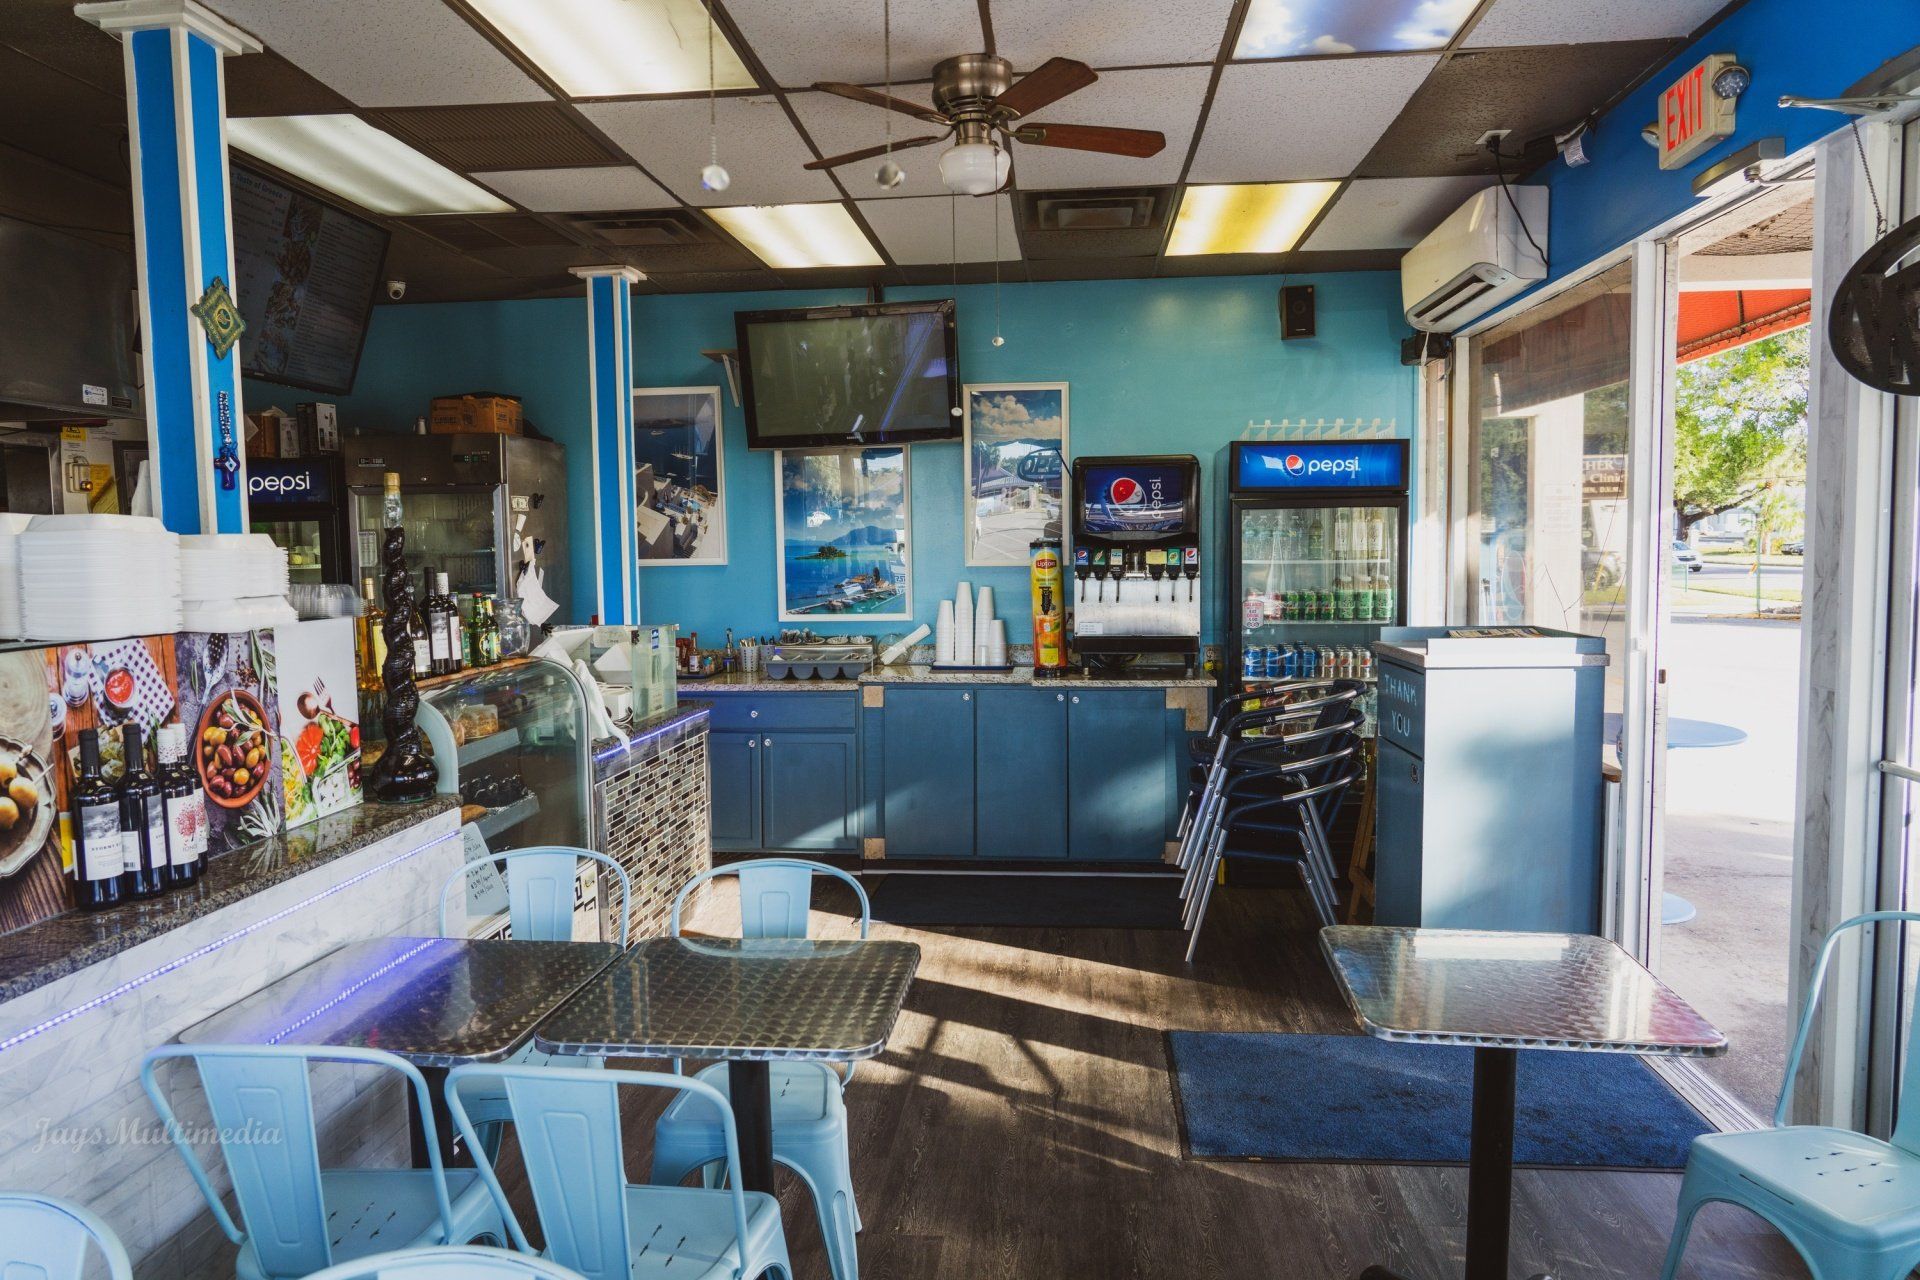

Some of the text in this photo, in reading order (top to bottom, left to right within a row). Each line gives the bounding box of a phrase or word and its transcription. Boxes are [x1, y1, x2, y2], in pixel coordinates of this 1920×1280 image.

[1665, 65, 1705, 152] EXIT
[1308, 456, 1360, 475] pepsi
[249, 471, 311, 496] pepsi
[1150, 478, 1165, 519] pepsi
[1037, 560, 1056, 568] Lipton
[1384, 673, 1417, 706] THANK
[1391, 710, 1410, 737] YOU
